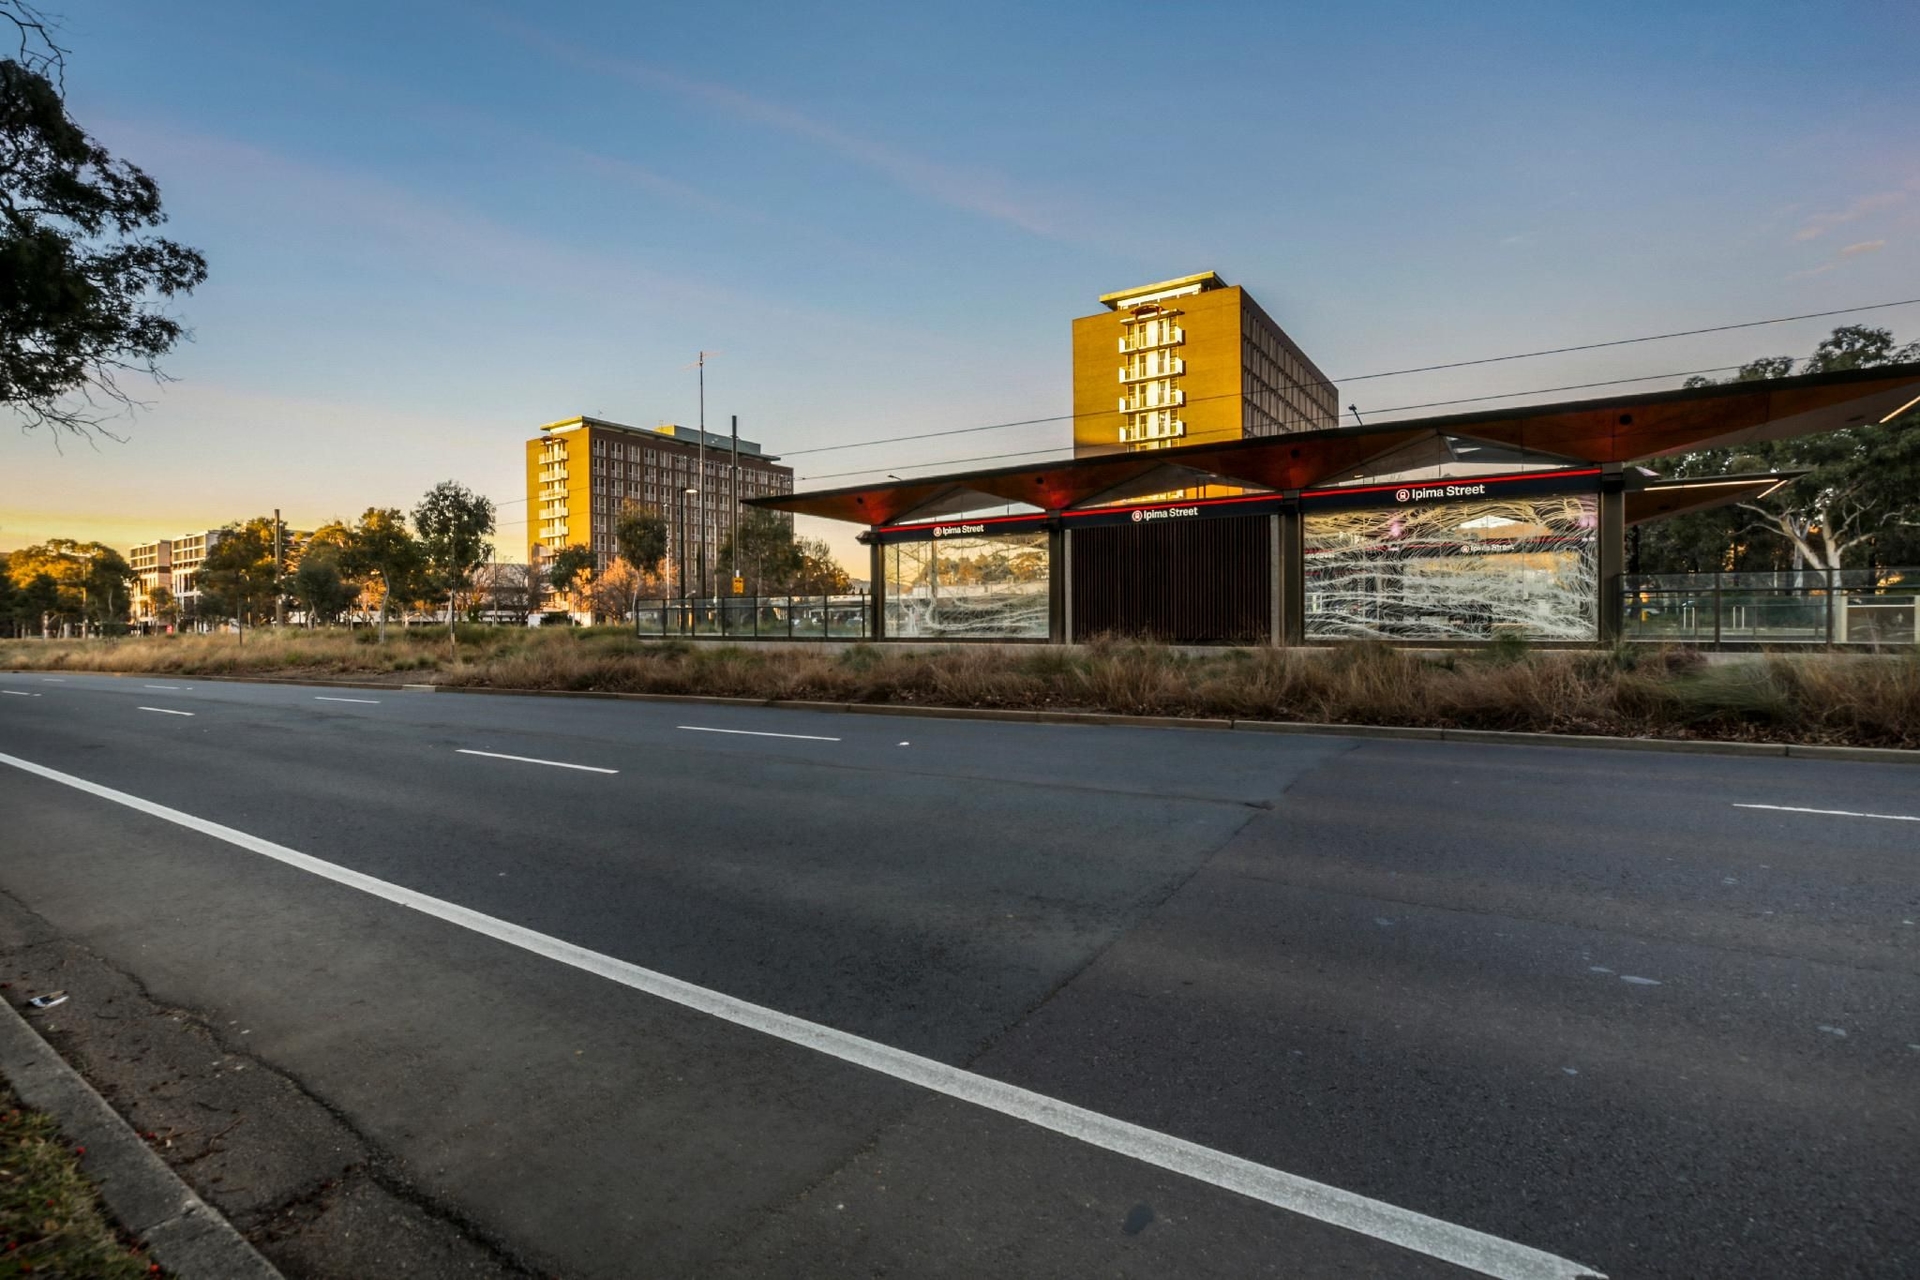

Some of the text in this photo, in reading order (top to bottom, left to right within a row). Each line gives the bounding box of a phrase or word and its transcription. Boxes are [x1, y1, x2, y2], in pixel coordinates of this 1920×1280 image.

[1412, 484, 1486, 501] Ipima Street
[1143, 507, 1198, 521] Ipima Street
[942, 524, 984, 536] Ipima Street
